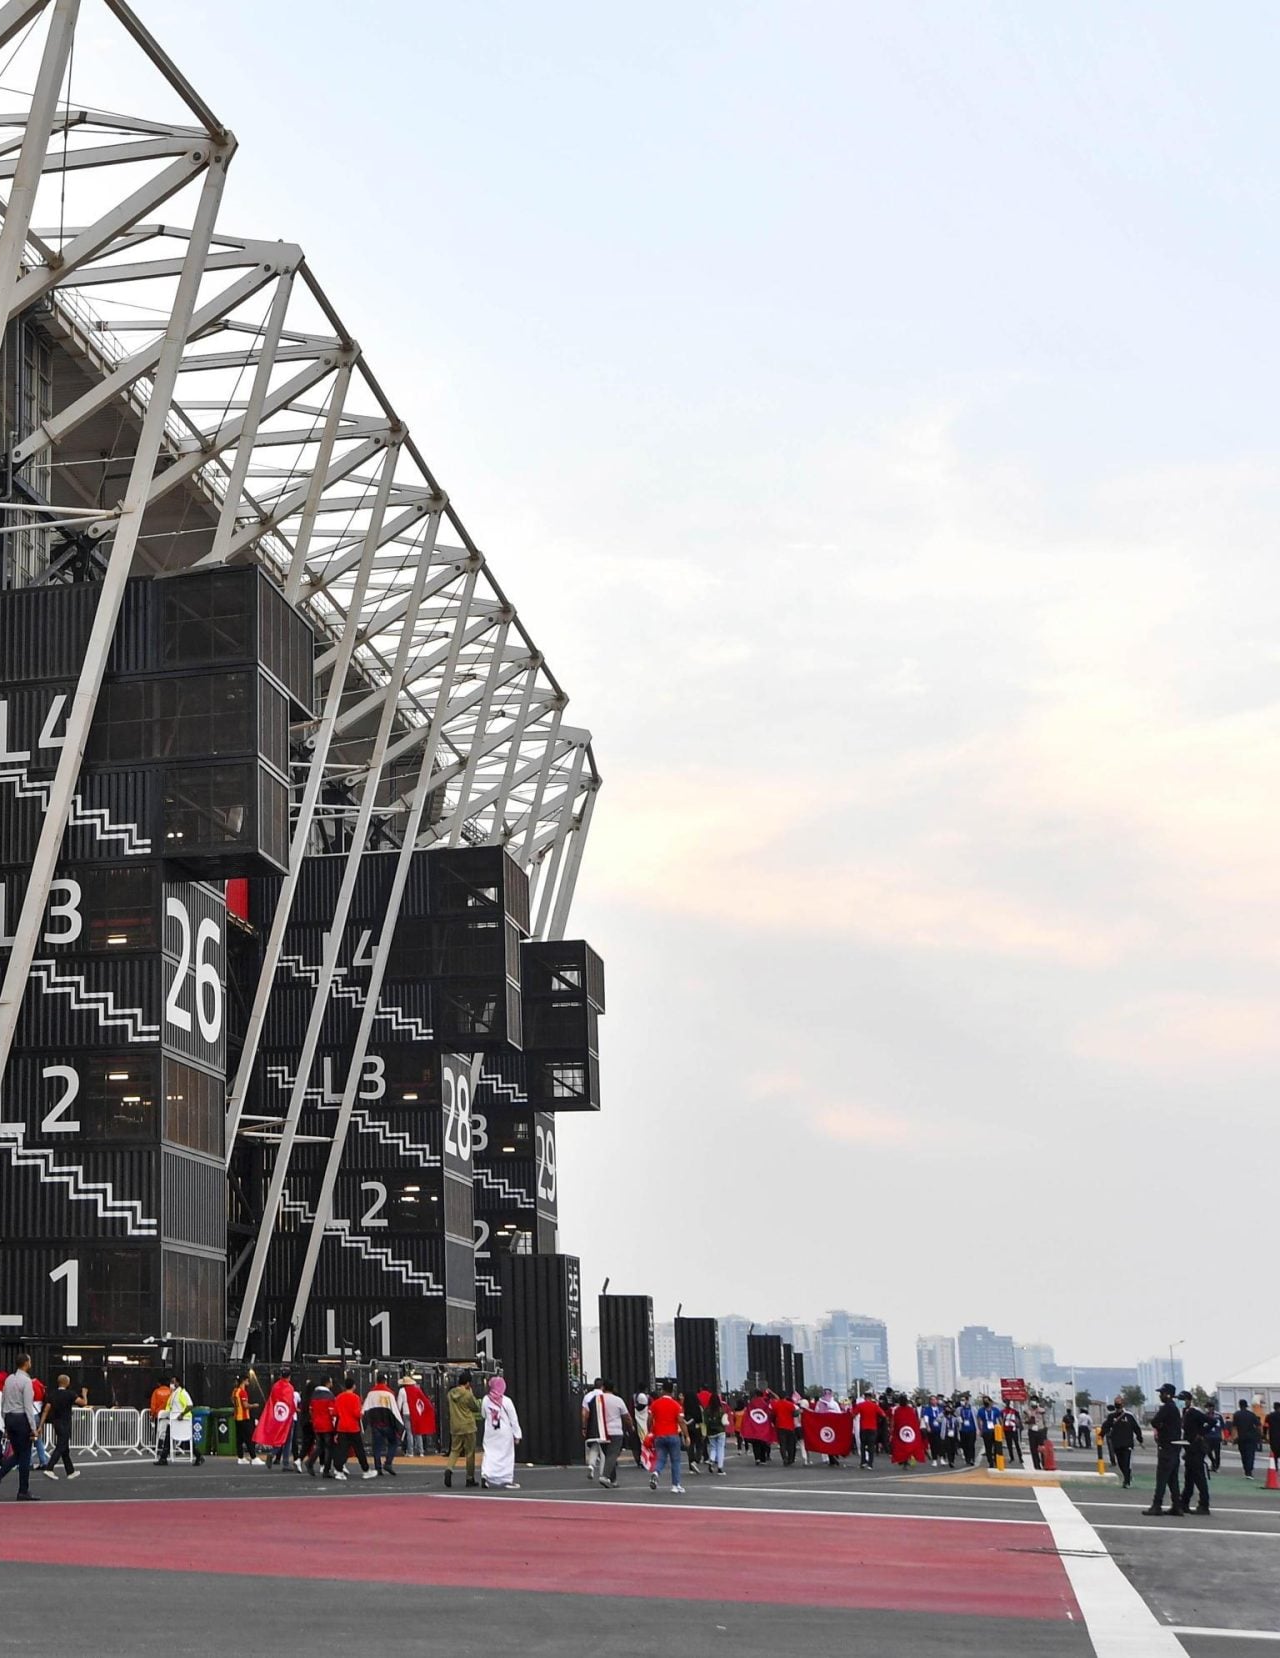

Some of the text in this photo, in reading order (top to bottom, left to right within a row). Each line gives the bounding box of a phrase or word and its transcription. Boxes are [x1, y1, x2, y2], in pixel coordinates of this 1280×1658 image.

[166, 897, 222, 1044] 26
[323, 1055, 386, 1100] L3
[443, 1066, 471, 1161] 28
[536, 1125, 556, 1202] 29
[326, 1309, 390, 1356] L1
